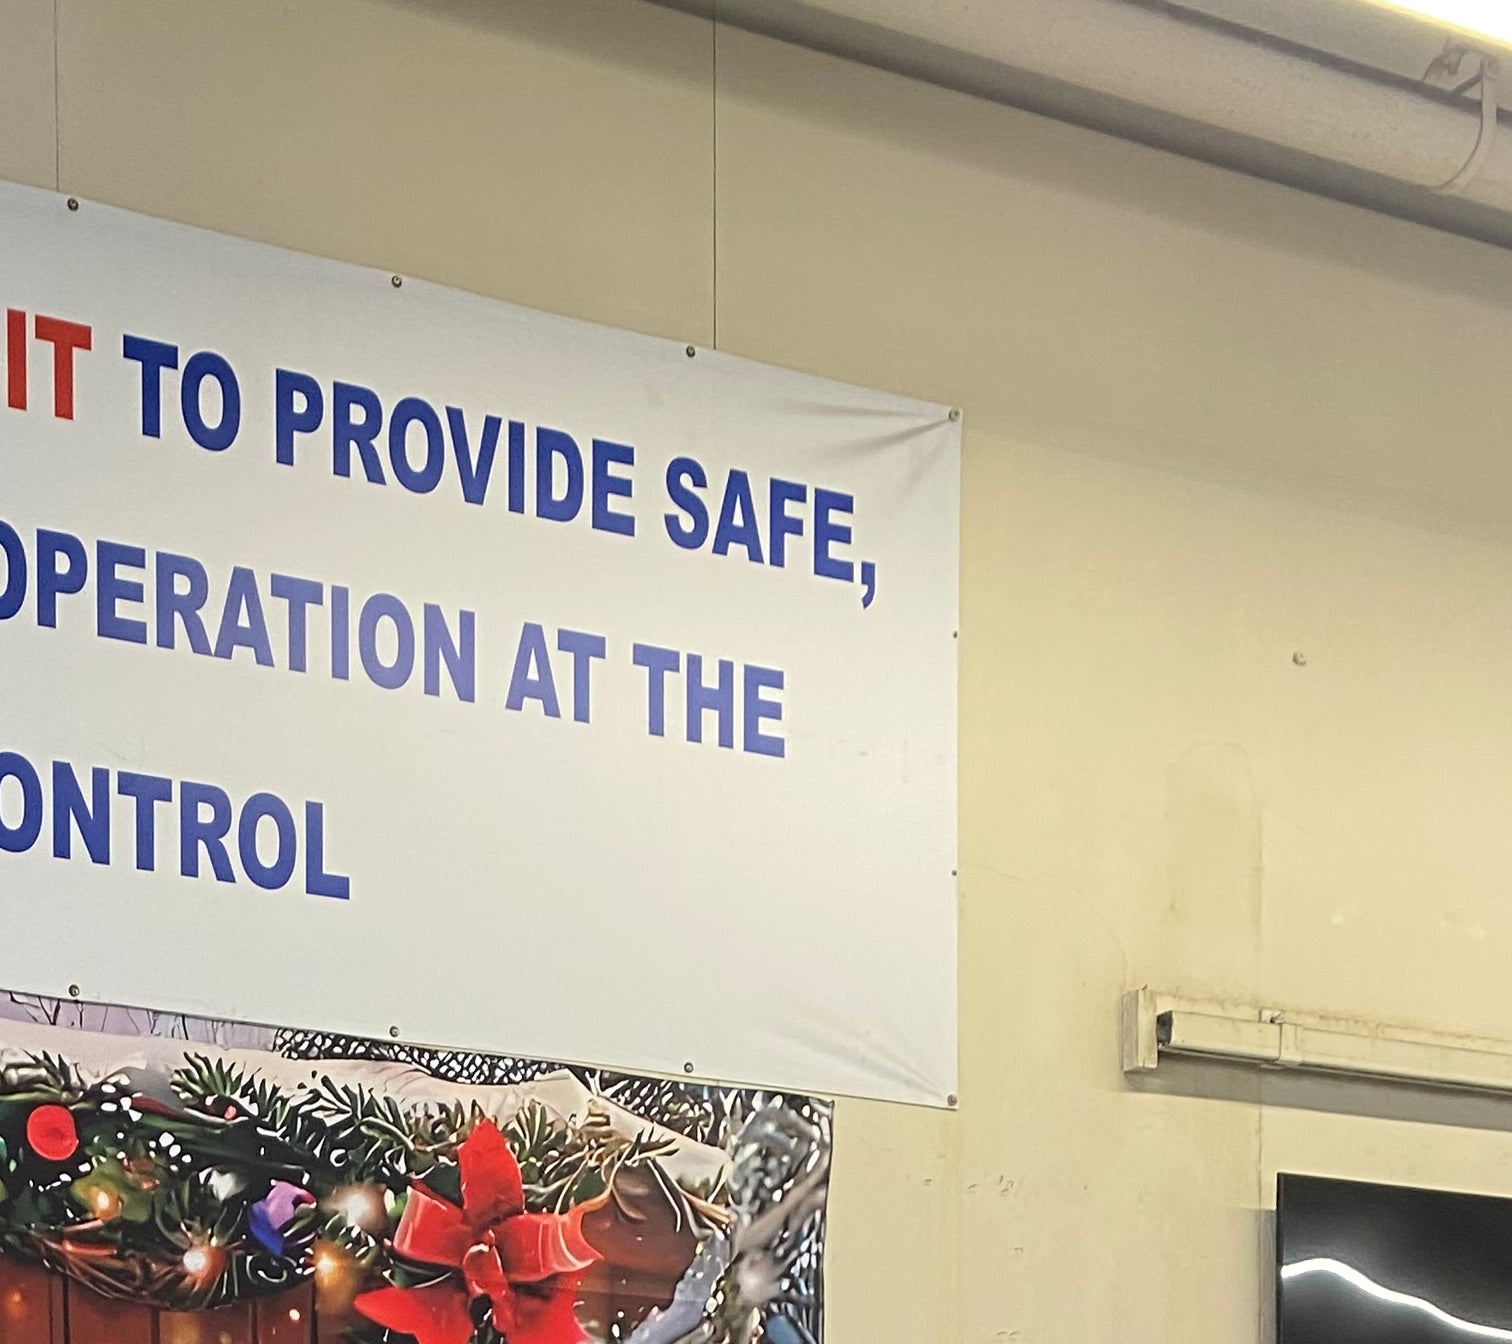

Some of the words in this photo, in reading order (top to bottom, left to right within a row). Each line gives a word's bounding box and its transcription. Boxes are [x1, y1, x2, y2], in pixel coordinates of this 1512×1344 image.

[124, 336, 240, 451] TO
[276, 370, 637, 537] PROVIDE
[665, 458, 876, 607] SAFE,
[506, 622, 606, 724] AT
[633, 642, 786, 758] THE
